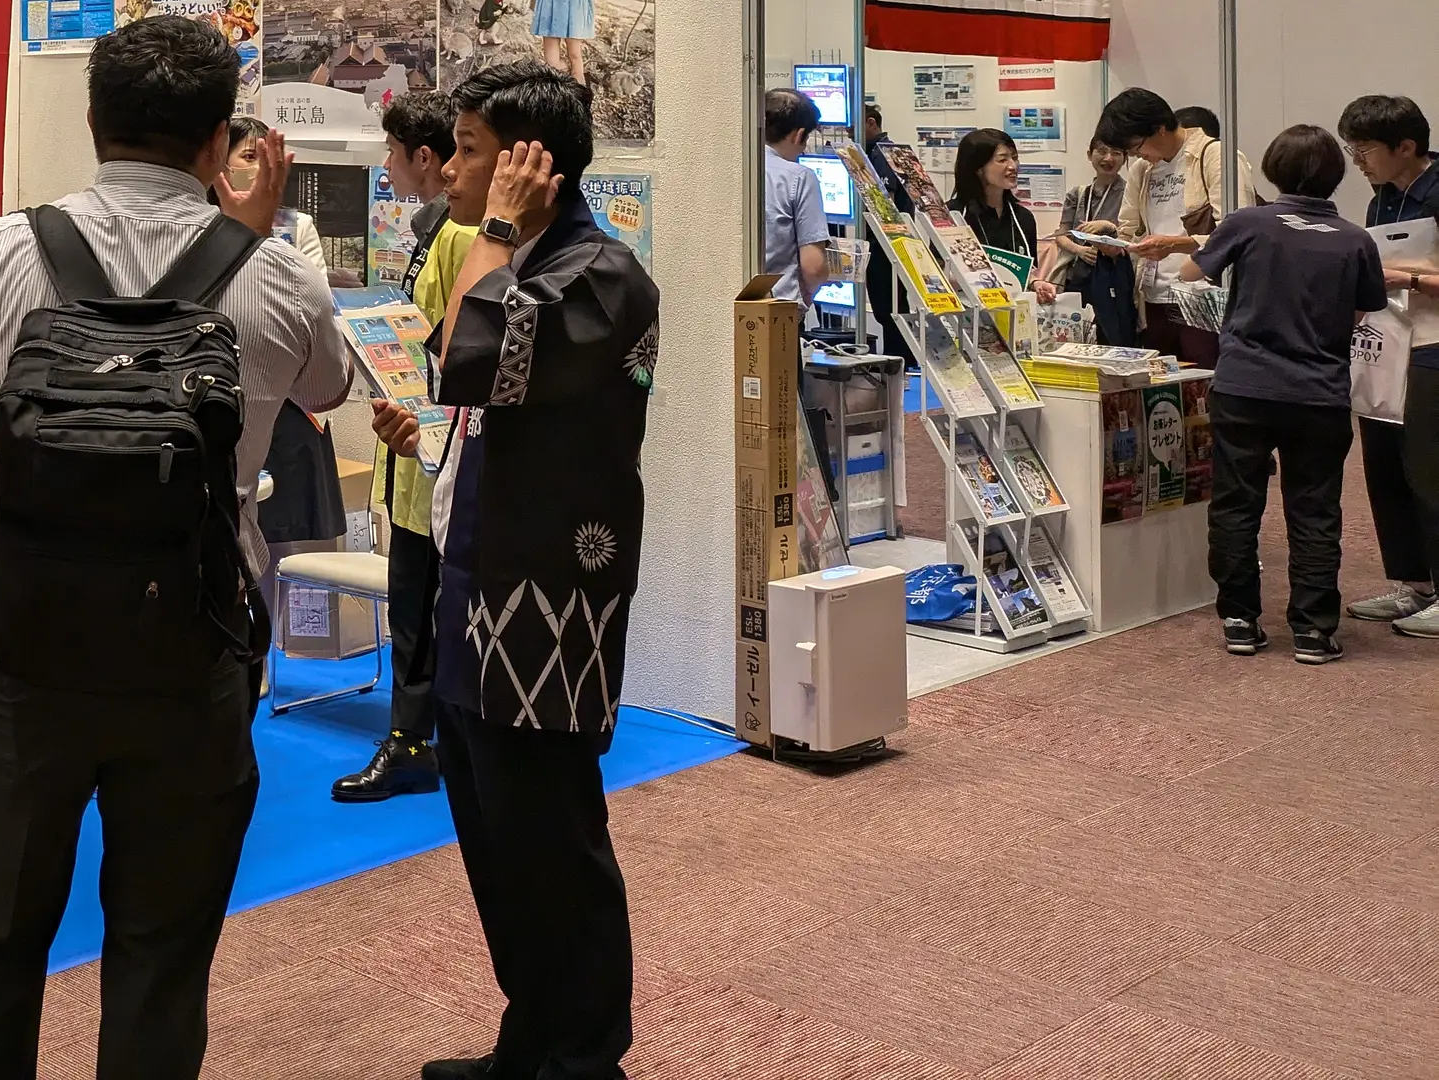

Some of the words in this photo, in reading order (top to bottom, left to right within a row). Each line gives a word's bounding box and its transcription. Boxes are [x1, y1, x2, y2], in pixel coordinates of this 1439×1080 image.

[275, 106, 325, 125] 東広島
[1151, 432, 1182, 449] プレゼント
[745, 611, 753, 634] ESL-
[754, 610, 762, 637] 1380
[747, 645, 760, 707] イーゼル
